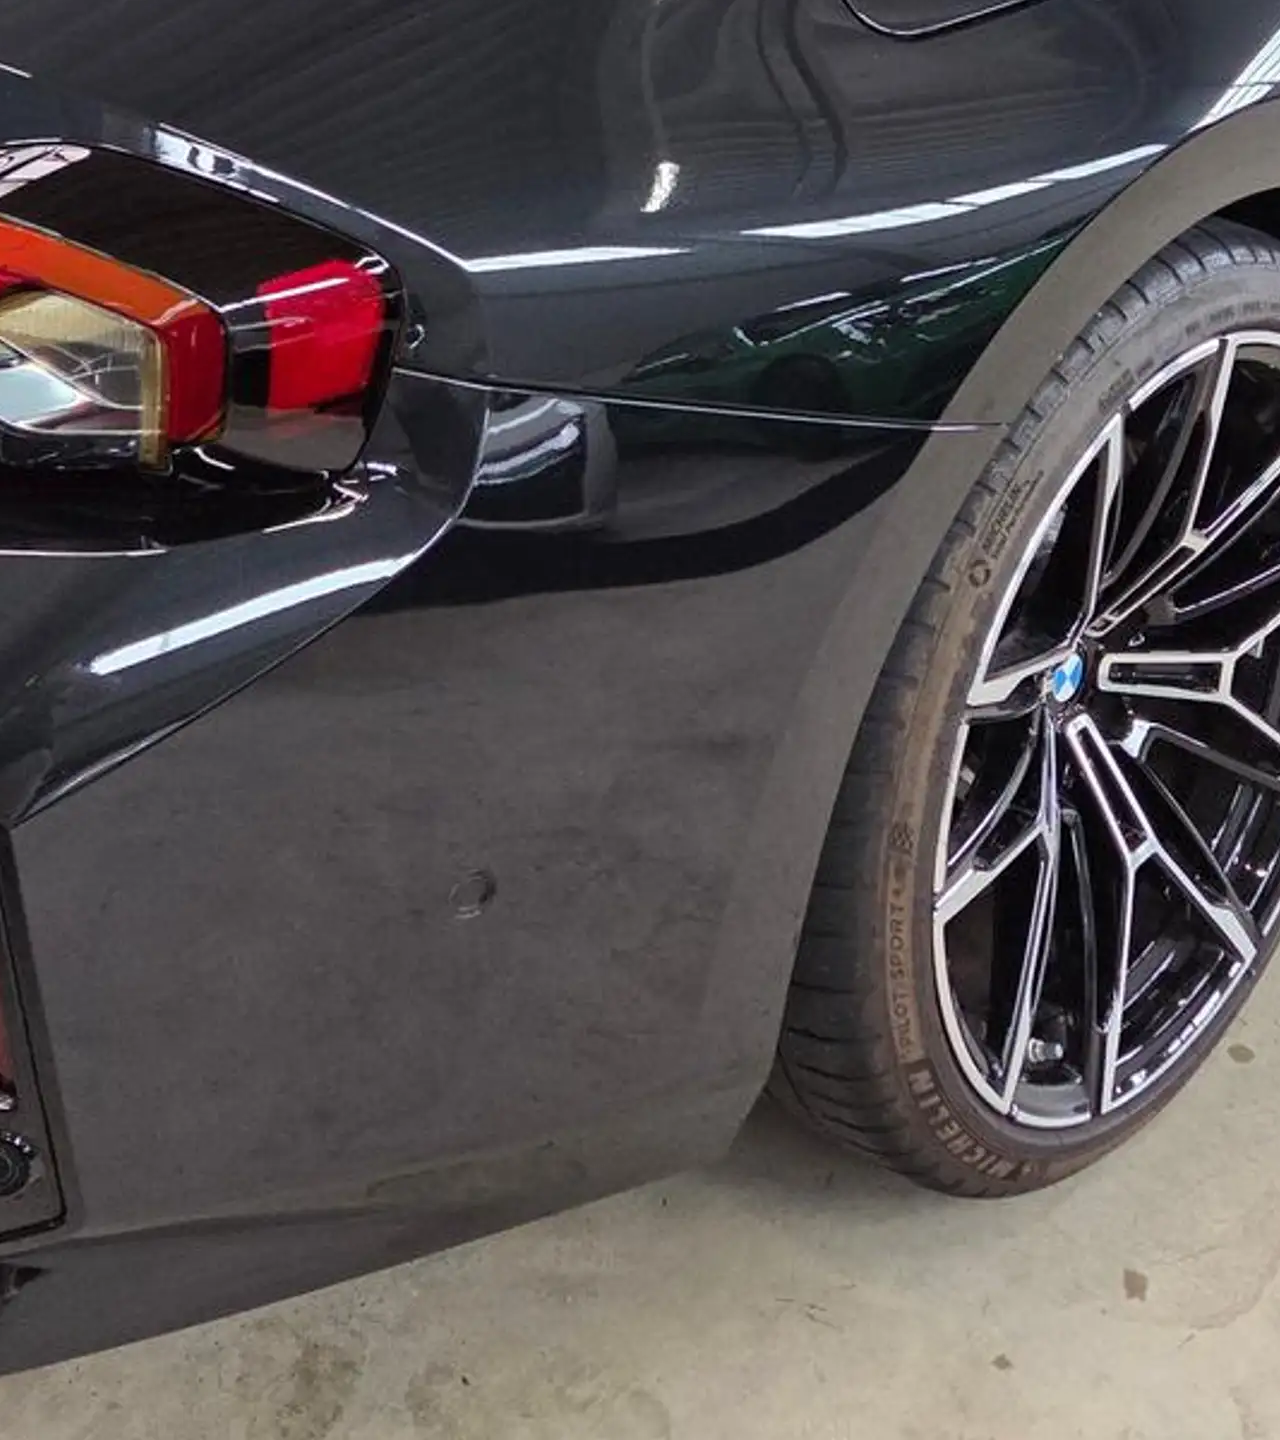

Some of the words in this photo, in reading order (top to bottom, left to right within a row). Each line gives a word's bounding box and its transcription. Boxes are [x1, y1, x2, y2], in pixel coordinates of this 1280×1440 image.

[889, 902, 906, 981] SPORT
[891, 991, 914, 1050] PILOT
[908, 1069, 1017, 1181] MICHELIN
